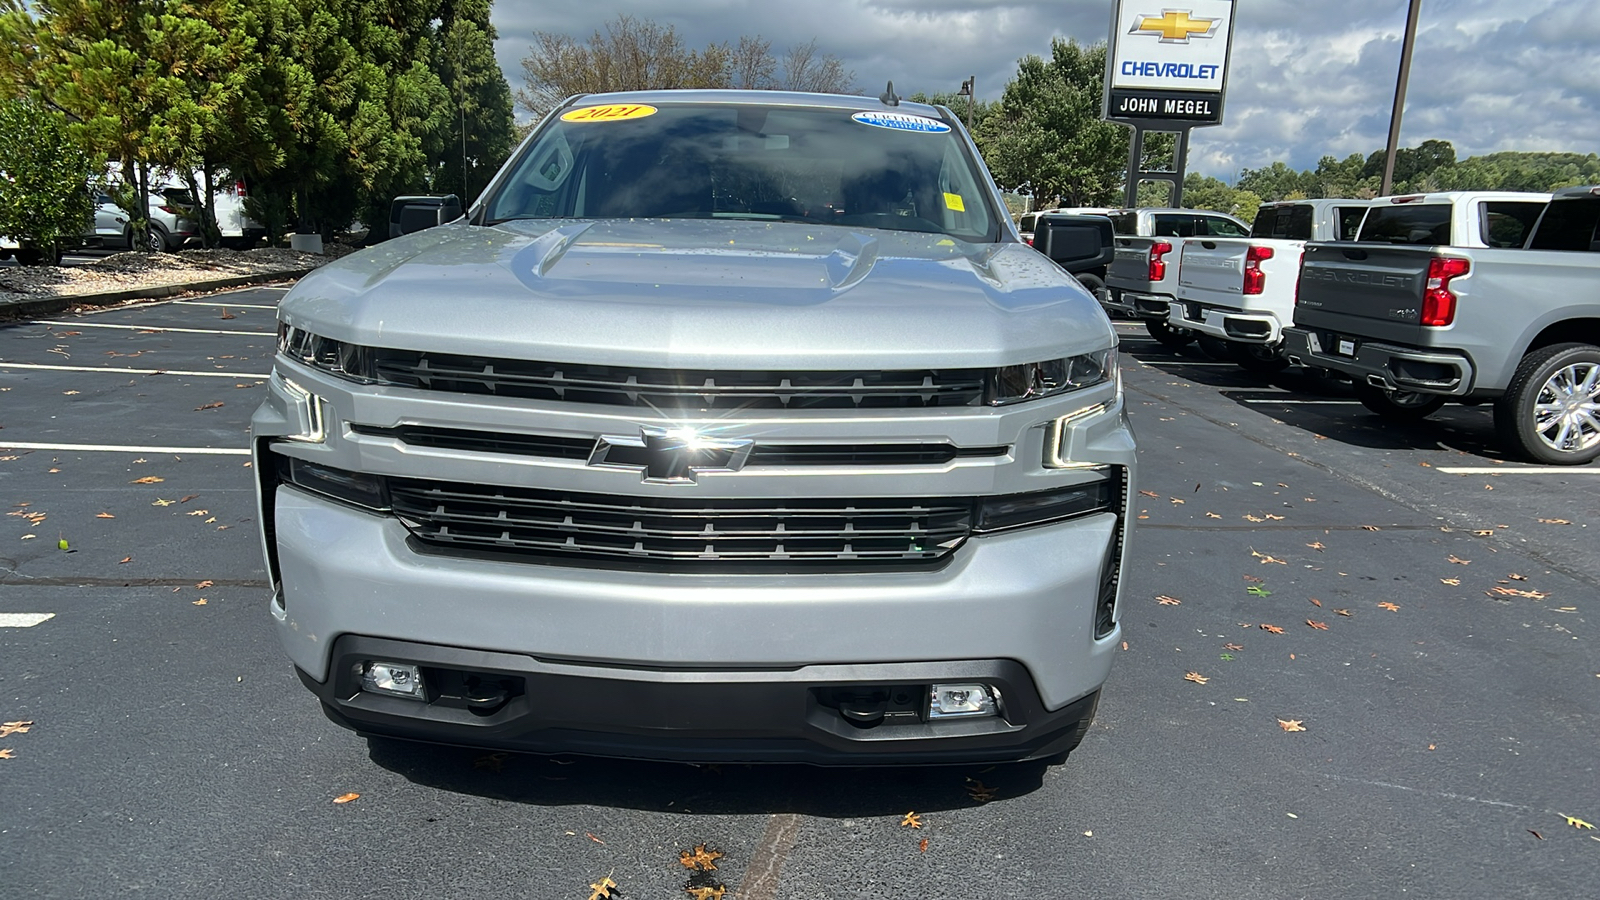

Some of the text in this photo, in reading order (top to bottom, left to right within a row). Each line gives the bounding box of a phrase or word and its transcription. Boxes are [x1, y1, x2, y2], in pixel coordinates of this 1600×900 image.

[1122, 61, 1219, 79] CHEVROLET
[573, 106, 641, 119] 2021
[1120, 98, 1212, 114] JOHN MEGEL
[1304, 269, 1412, 288] CHEVROLET
